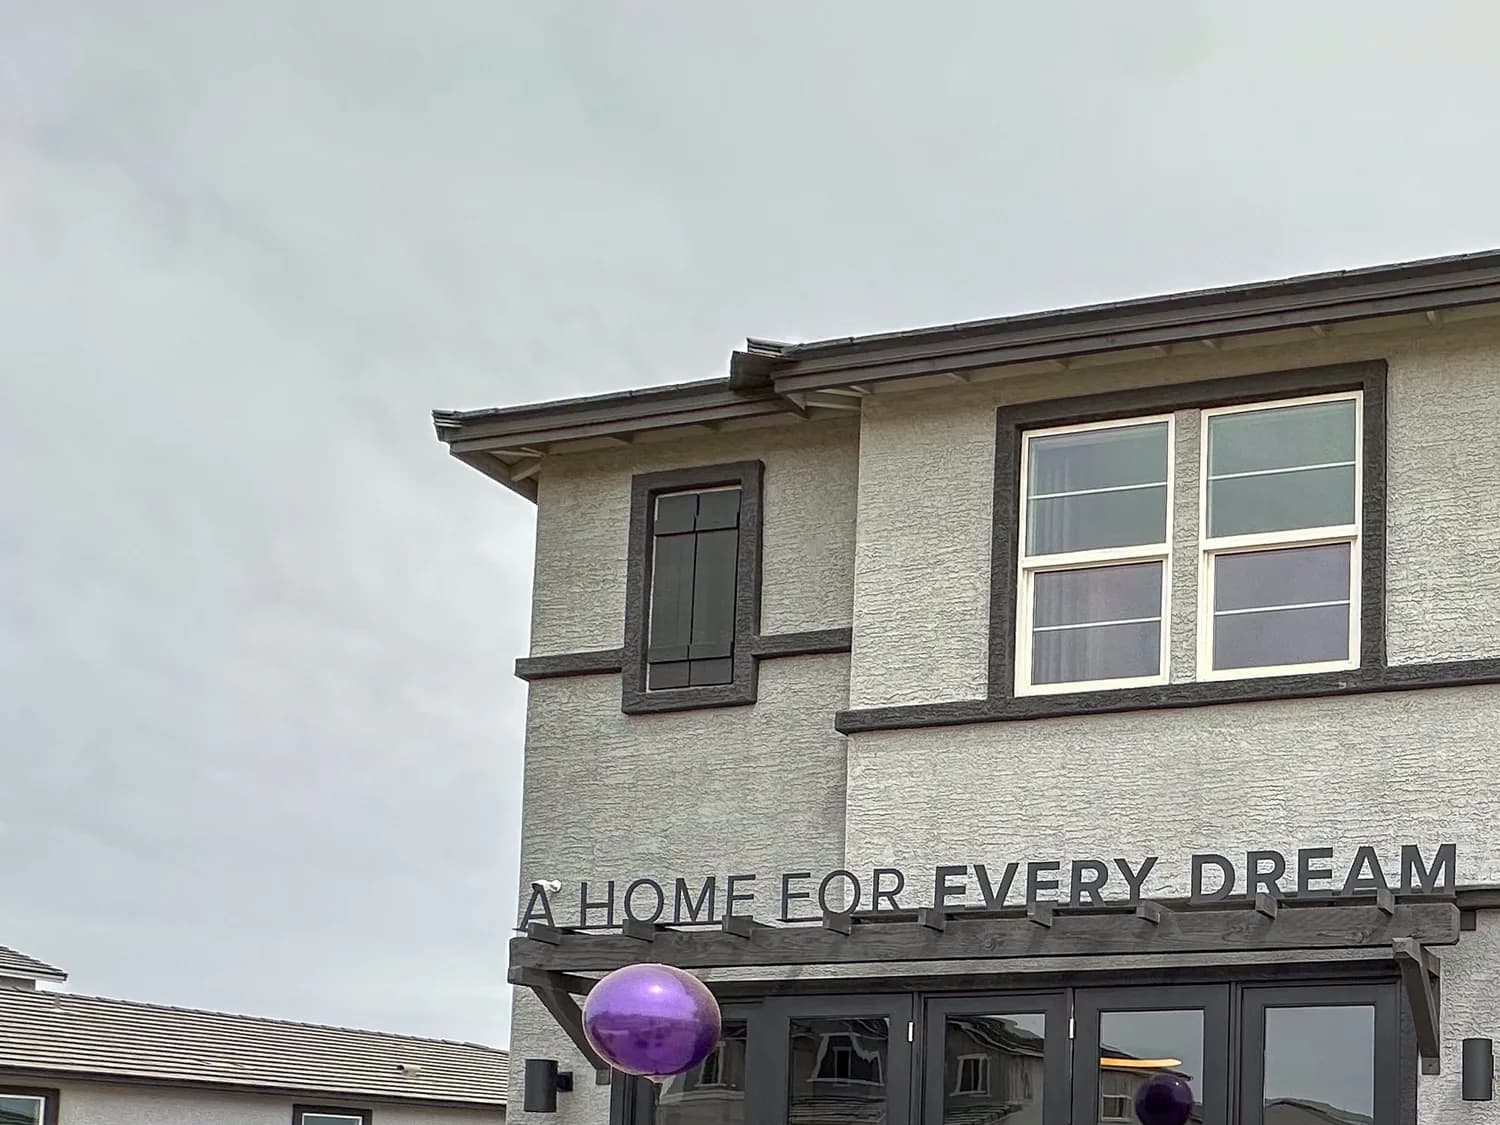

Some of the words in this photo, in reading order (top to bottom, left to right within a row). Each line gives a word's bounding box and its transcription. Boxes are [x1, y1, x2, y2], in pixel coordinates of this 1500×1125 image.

[521, 882, 555, 928] A
[580, 874, 757, 927] HOME
[781, 867, 905, 920] FOR
[934, 857, 1159, 912] EVERY
[1189, 843, 1457, 904] DREAM
